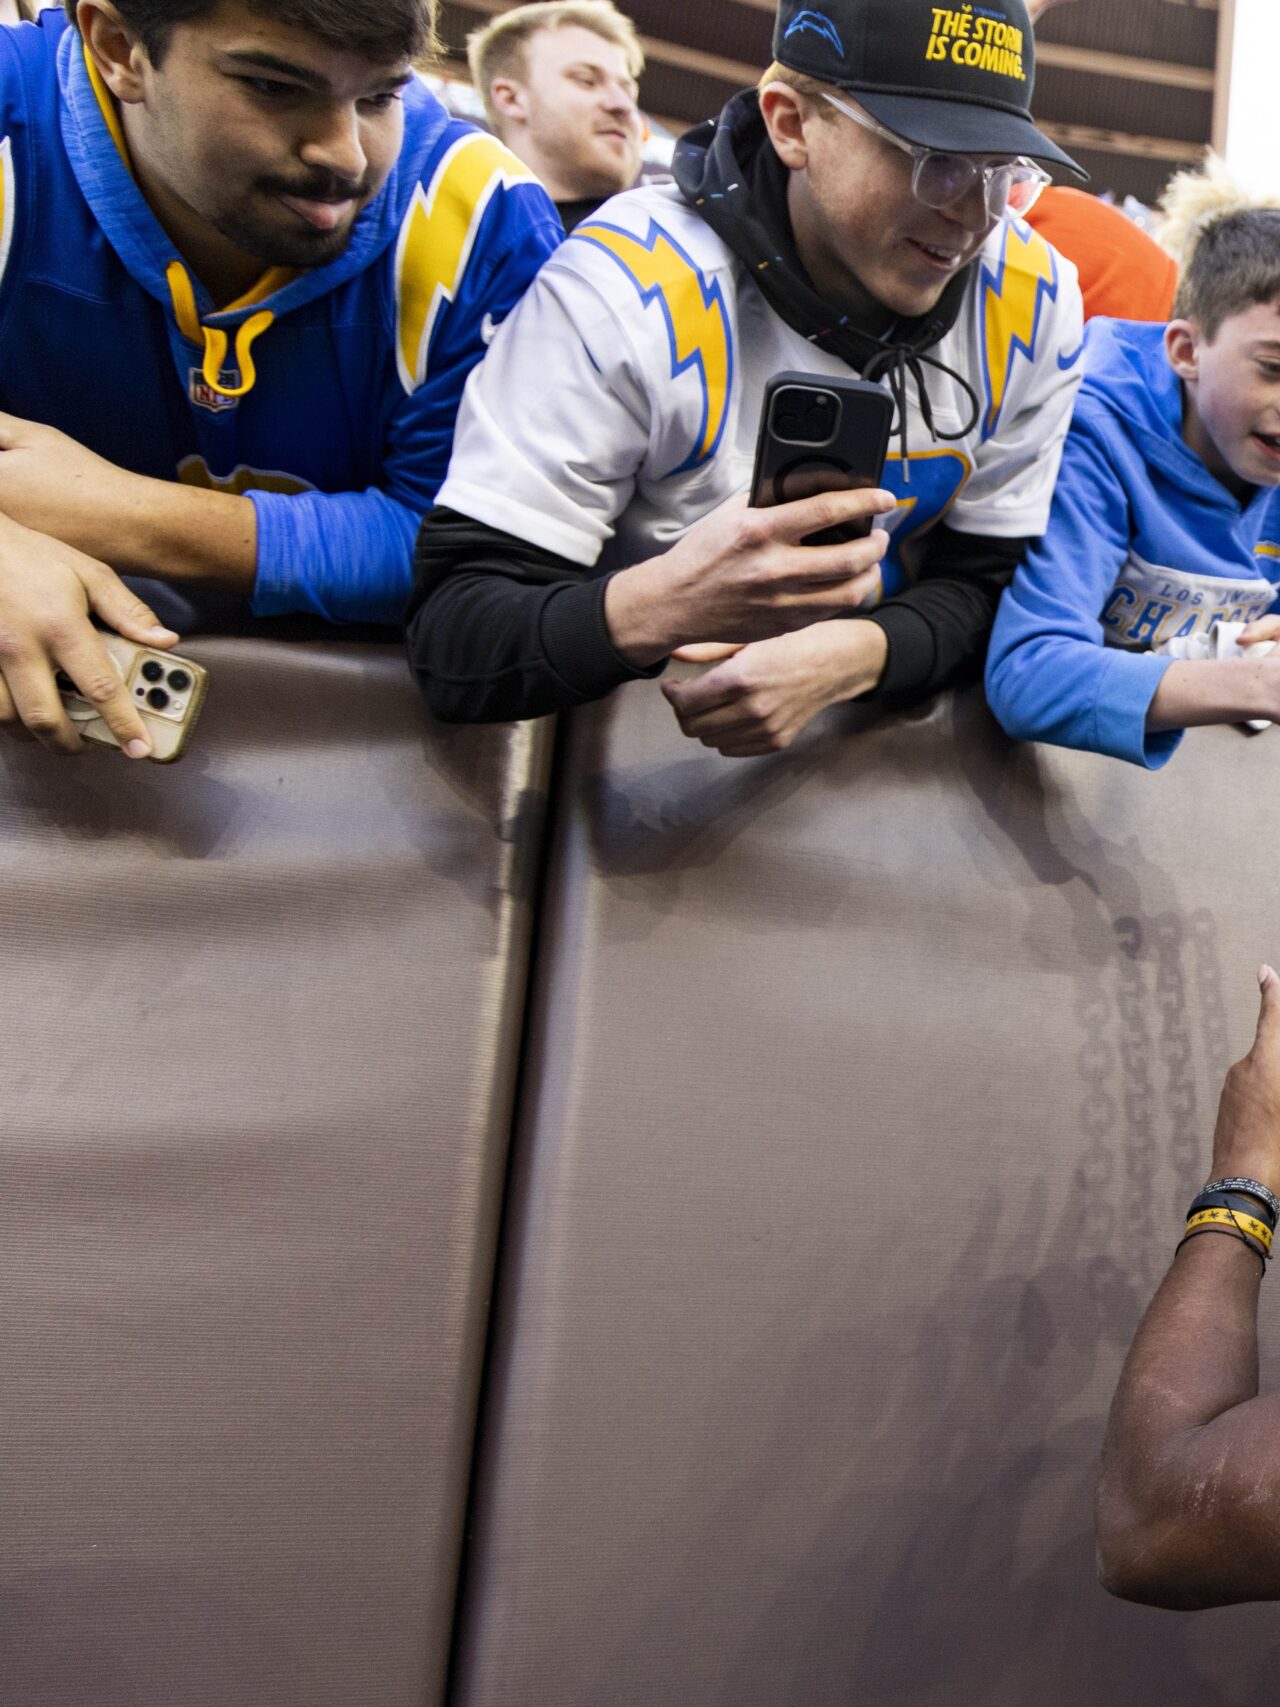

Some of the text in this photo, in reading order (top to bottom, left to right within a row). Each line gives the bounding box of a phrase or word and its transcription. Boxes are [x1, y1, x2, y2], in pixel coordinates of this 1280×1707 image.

[931, 7, 973, 38] THE
[972, 16, 1023, 56] STORM
[925, 33, 1026, 82] IS COMING.
[1160, 584, 1205, 605] LOS
